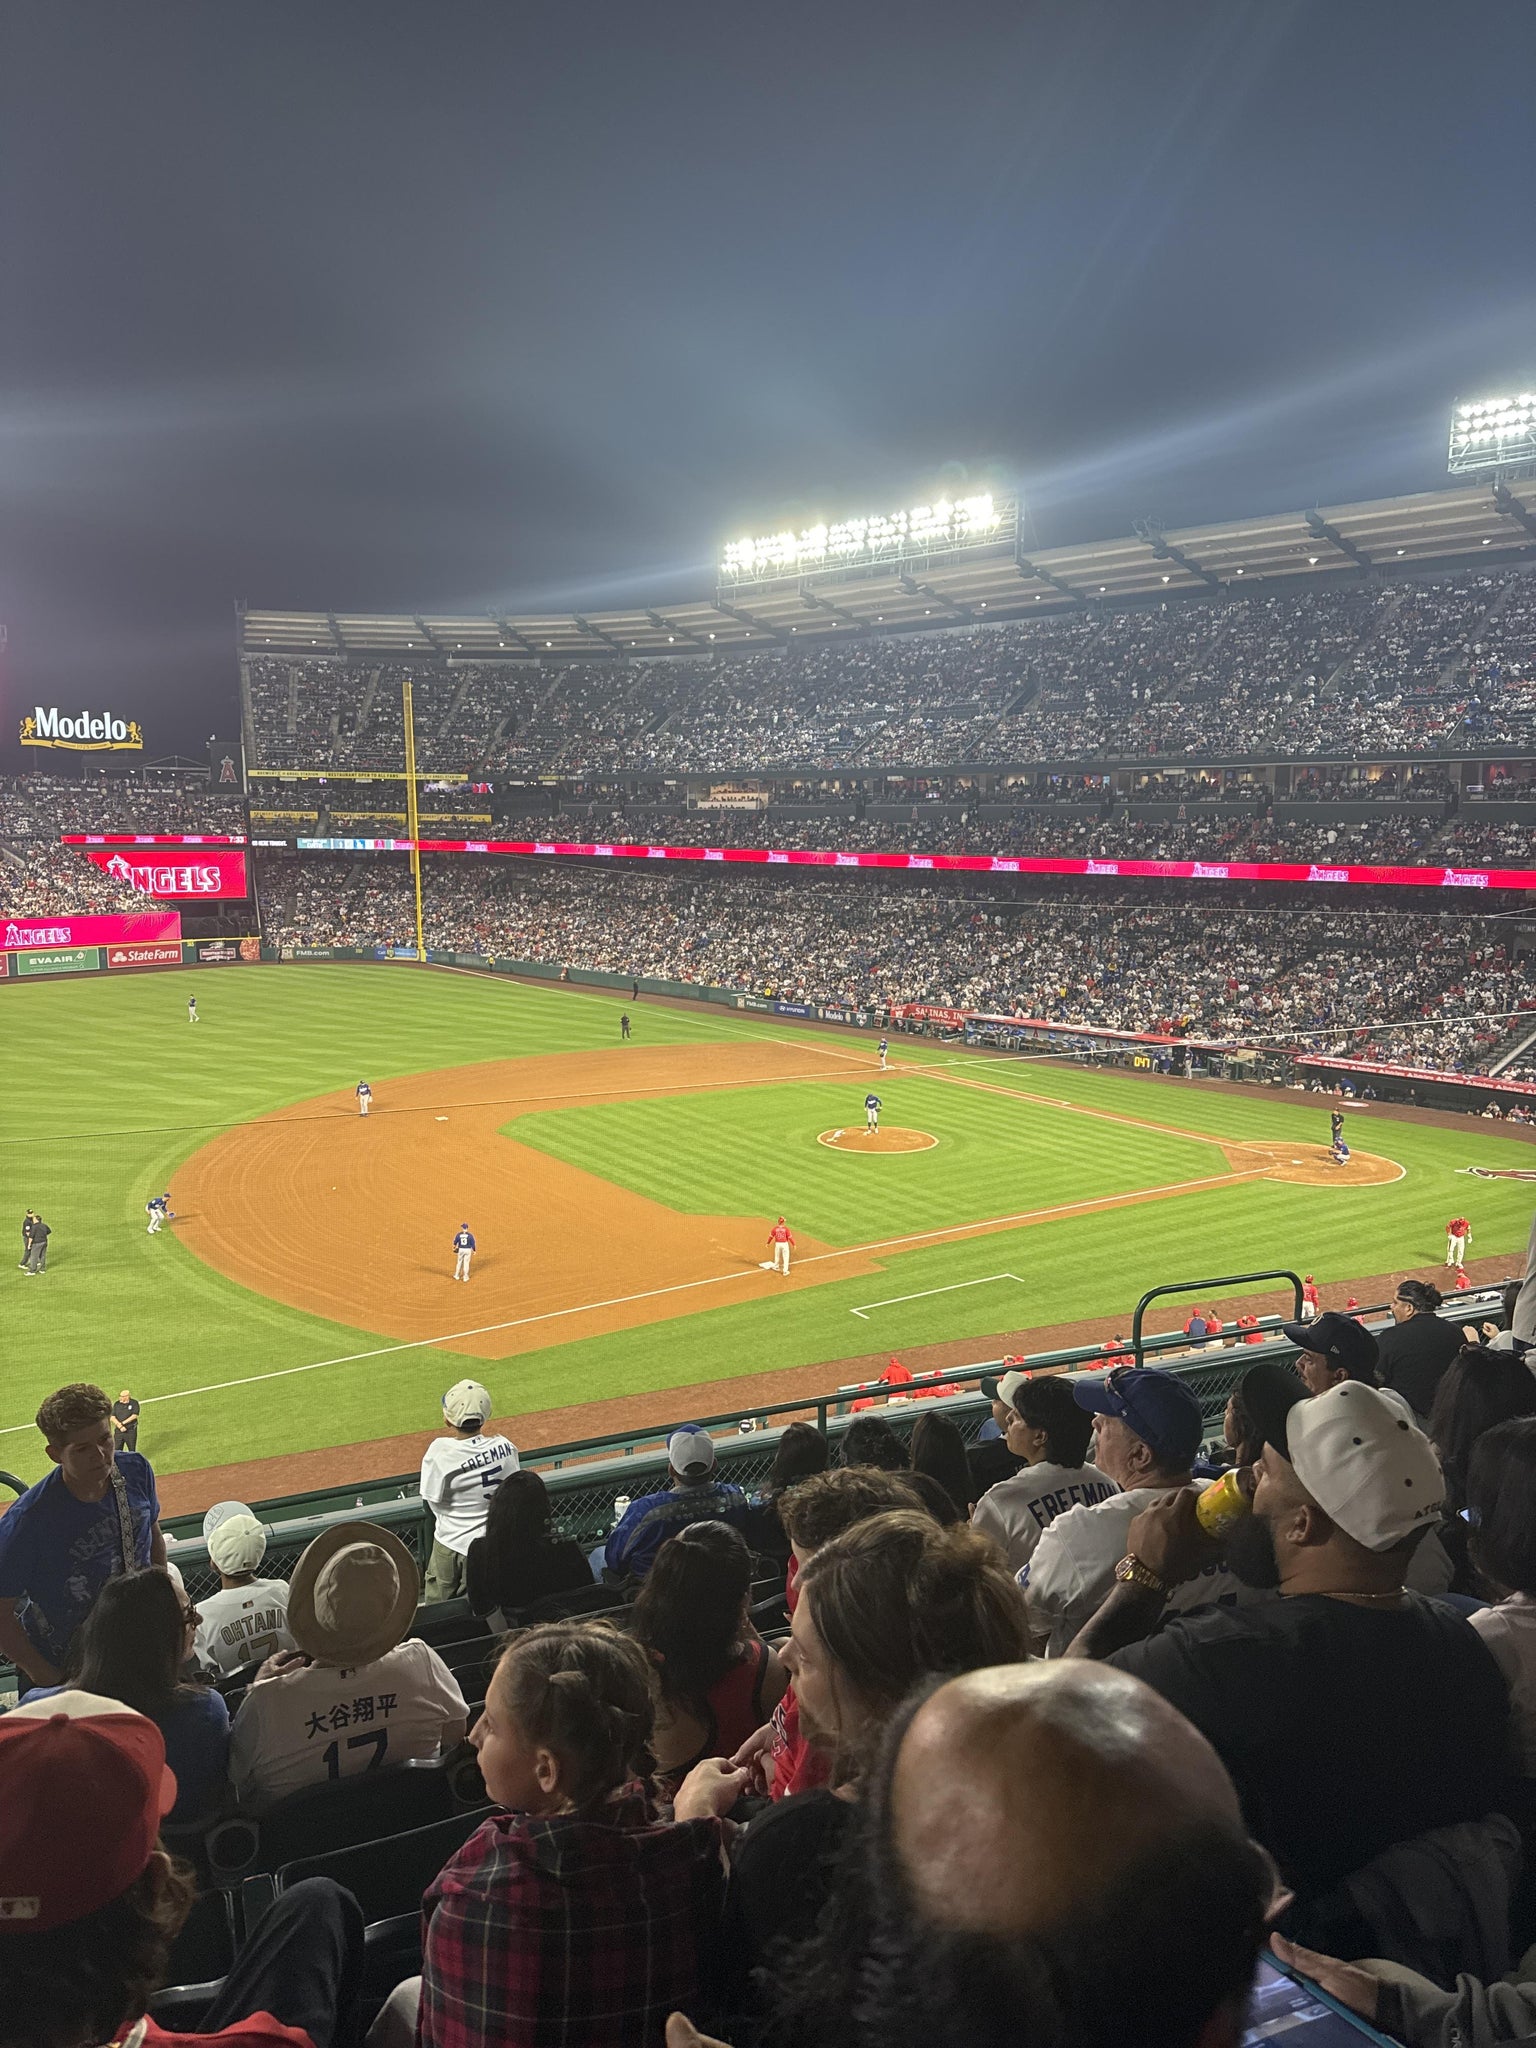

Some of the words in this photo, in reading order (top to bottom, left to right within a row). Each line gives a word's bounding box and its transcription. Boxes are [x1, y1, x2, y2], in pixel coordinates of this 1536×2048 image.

[35, 706, 127, 740] Modelo
[1307, 864, 1349, 882] ANGELS
[1442, 868, 1488, 887] ANGELS
[5, 922, 72, 947] ANGELS
[825, 1010, 844, 1021] Modelo
[461, 1443, 512, 1473] FREEMAN
[221, 1608, 283, 1646] OHTANI
[304, 1693, 398, 1739] 大谷翔平
[322, 1728, 388, 1781] 17
